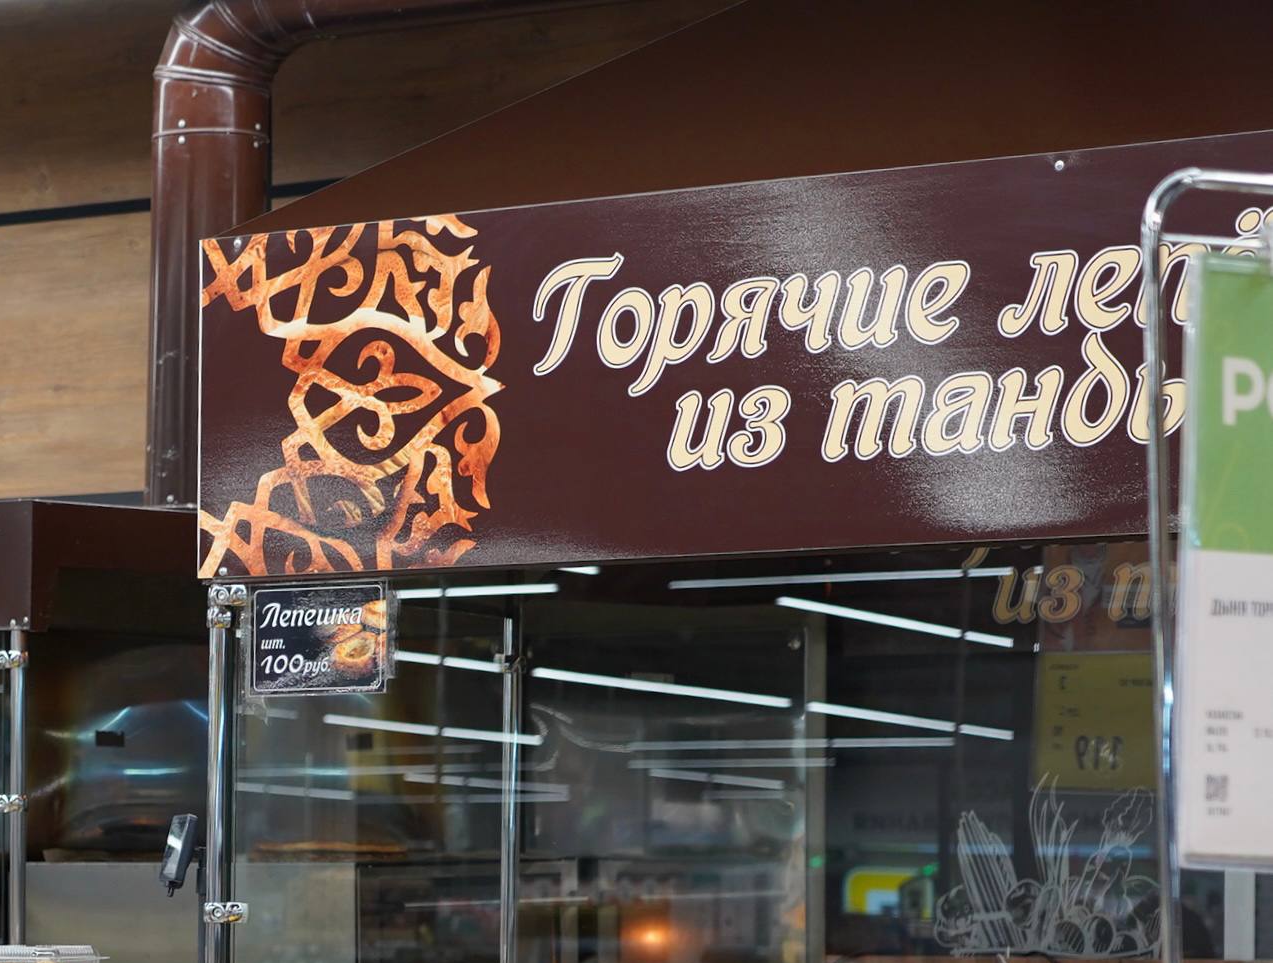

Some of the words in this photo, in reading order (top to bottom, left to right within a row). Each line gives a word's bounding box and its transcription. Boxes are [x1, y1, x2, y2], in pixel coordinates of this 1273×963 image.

[531, 251, 972, 398] Горячие
[667, 384, 792, 471] из
[259, 602, 363, 629] Лепешка
[260, 638, 286, 650] шт.
